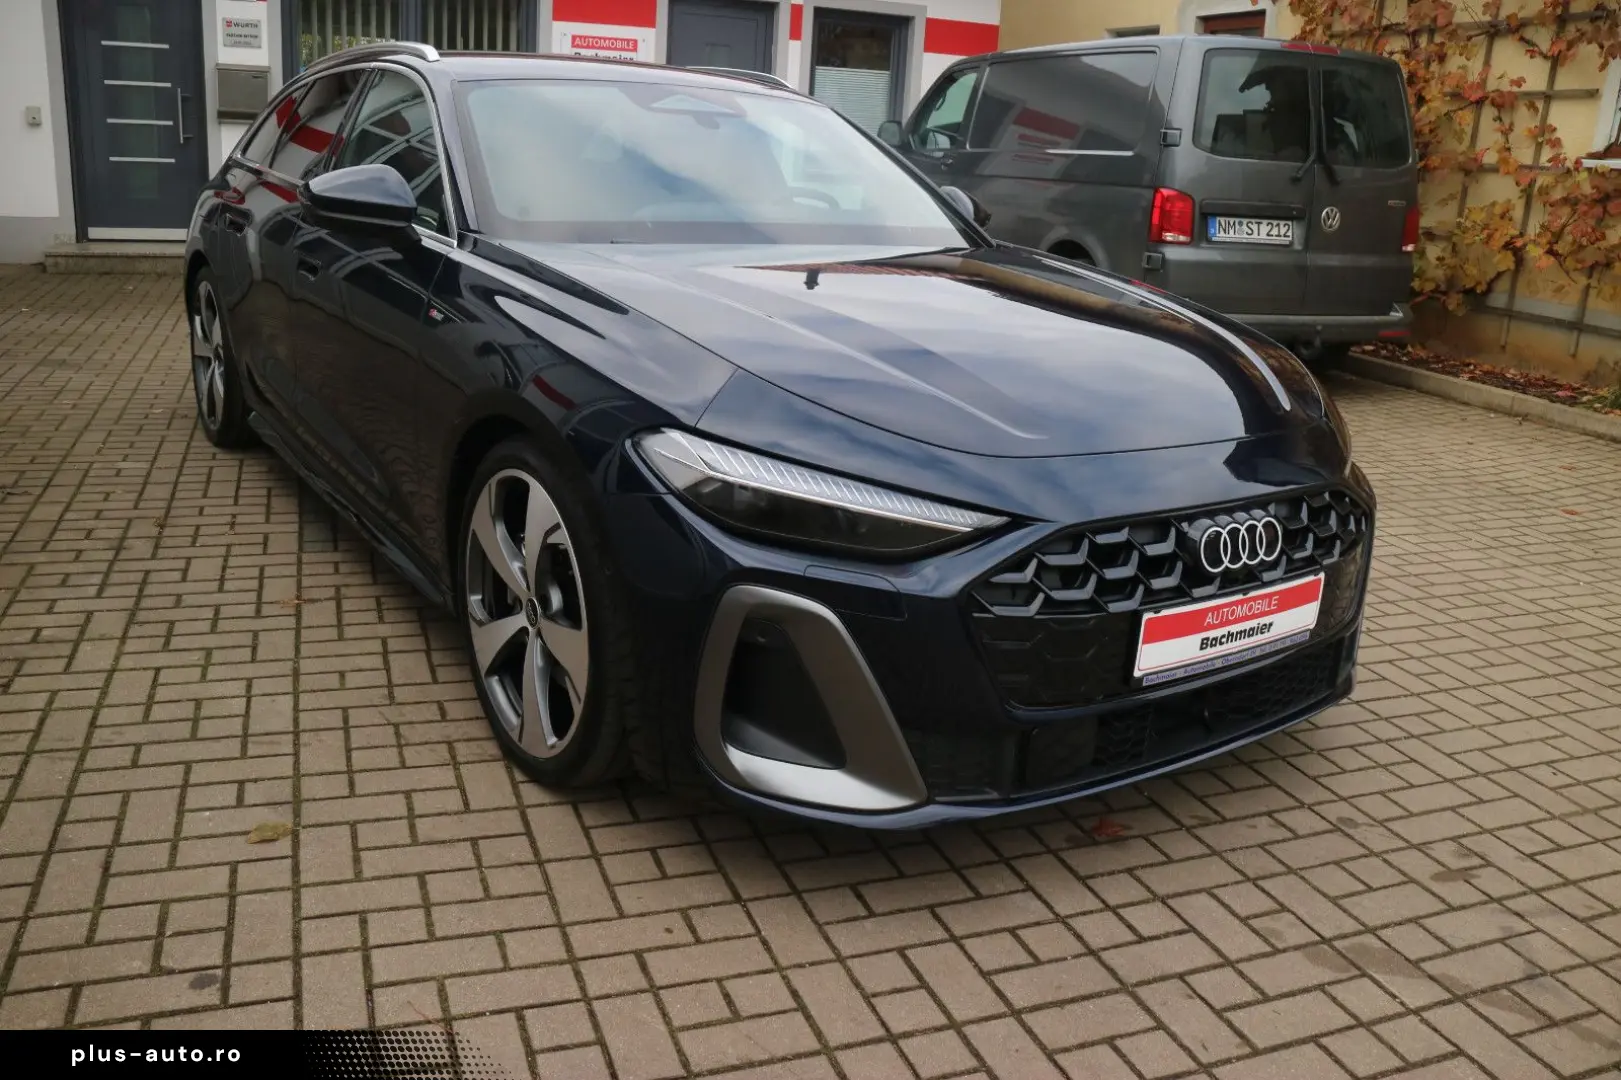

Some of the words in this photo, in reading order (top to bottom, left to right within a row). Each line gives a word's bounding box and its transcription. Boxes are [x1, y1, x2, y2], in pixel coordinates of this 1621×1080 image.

[574, 37, 634, 49] AUTOMOBILE
[1218, 219, 1237, 235] NM
[1245, 221, 1263, 237] ST
[1266, 222, 1291, 238] 212
[1204, 596, 1279, 627] AUTOMOBILE
[1199, 621, 1274, 651] Bachmaier
